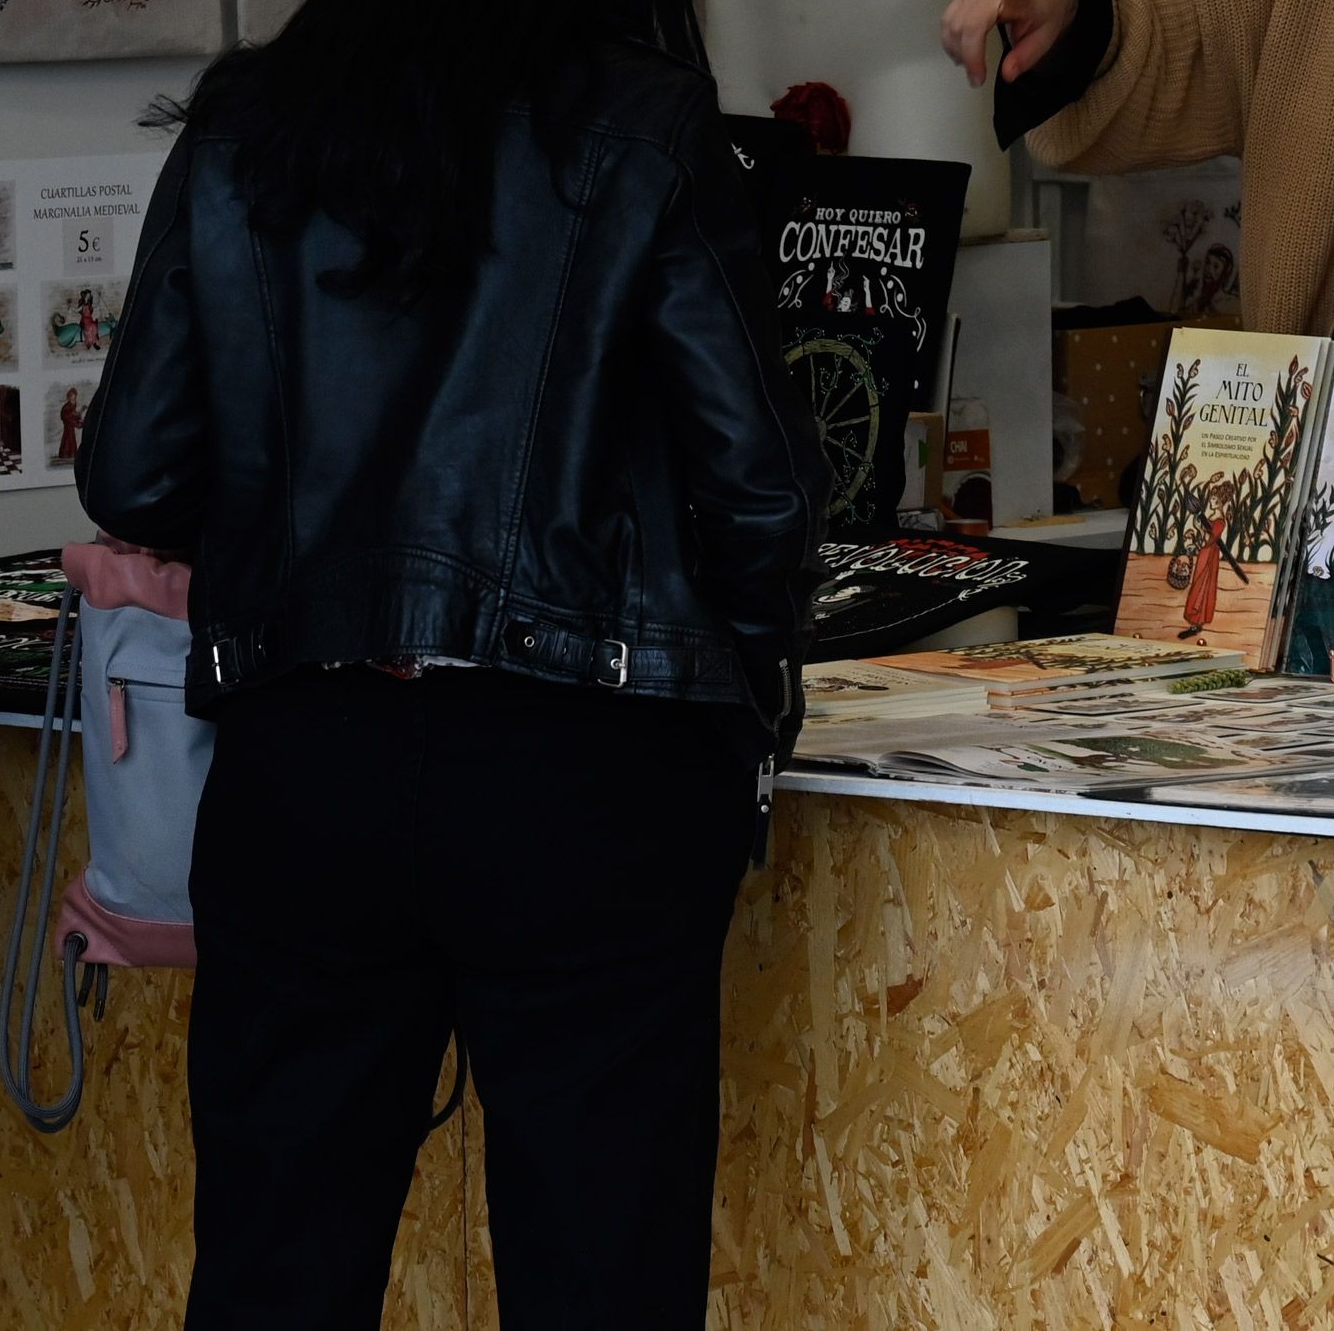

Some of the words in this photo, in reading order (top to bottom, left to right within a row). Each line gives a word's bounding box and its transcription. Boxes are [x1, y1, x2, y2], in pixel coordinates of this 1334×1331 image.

[40, 186, 97, 199] CUARTILLAS
[99, 184, 132, 196] POSTAL
[33, 205, 91, 219] MARGINALIA
[93, 203, 140, 216] MEDIEVAL
[815, 207, 846, 221] HOY
[849, 208, 901, 225] QUIERO
[78, 230, 89, 252] 5
[92, 237, 100, 251] €
[779, 221, 926, 270] CONFESAR
[1236, 363, 1249, 377] EL
[1216, 380, 1263, 402] MITO
[1199, 403, 1268, 427] GENITAL
